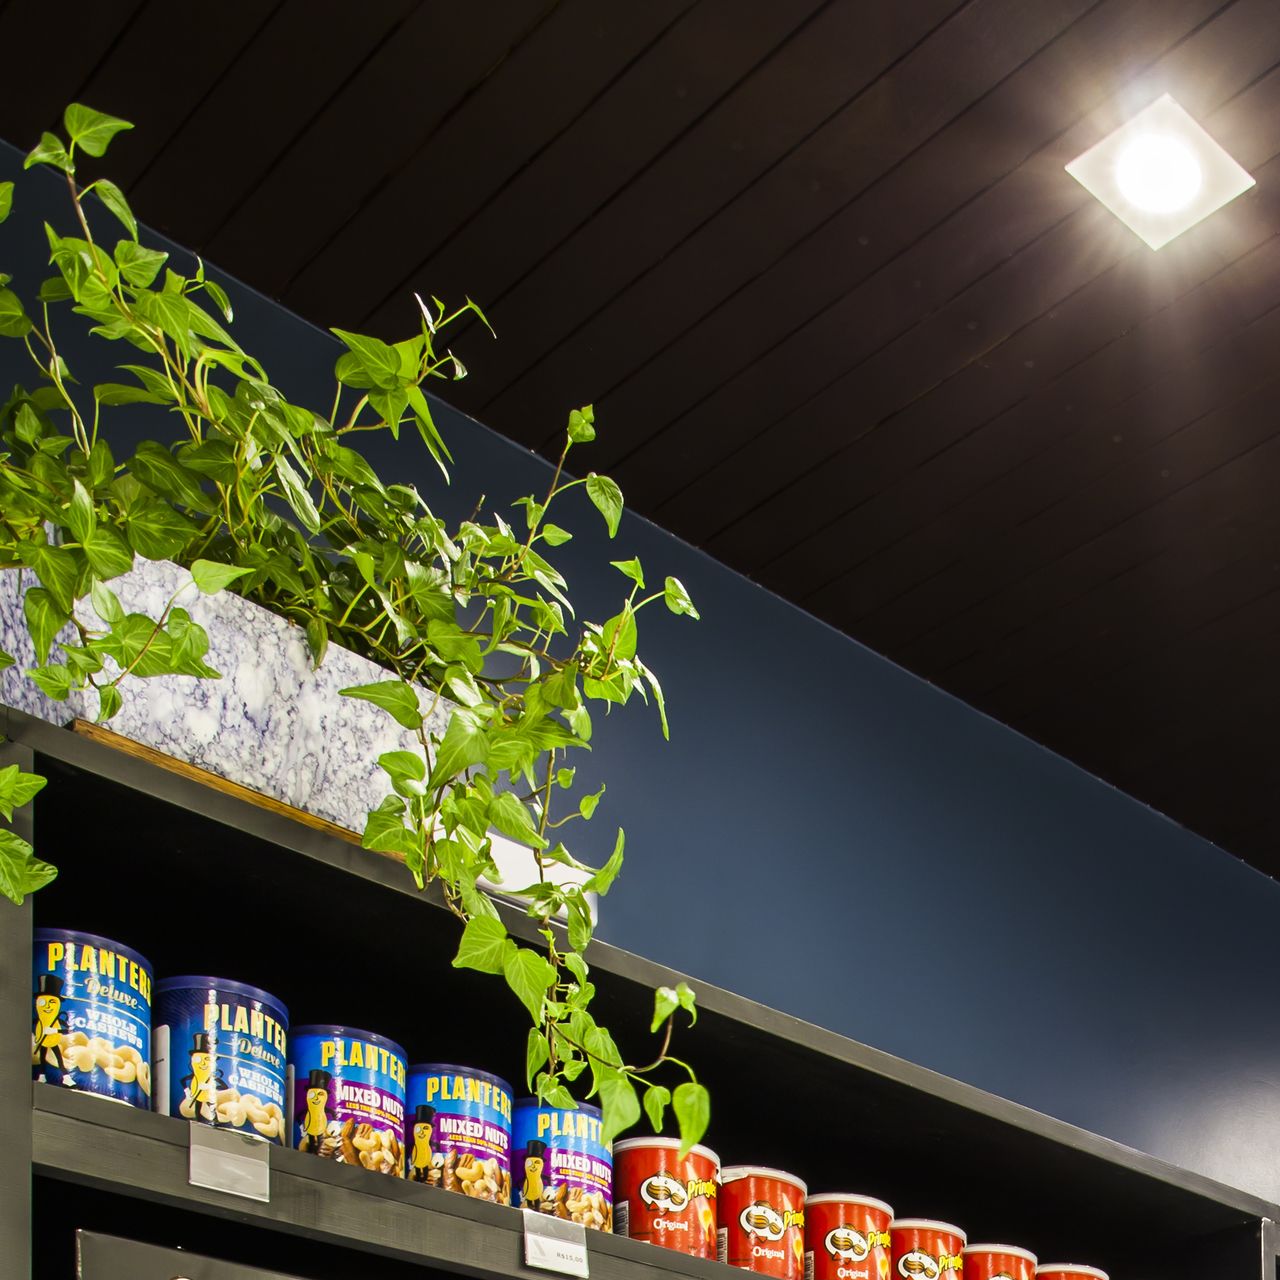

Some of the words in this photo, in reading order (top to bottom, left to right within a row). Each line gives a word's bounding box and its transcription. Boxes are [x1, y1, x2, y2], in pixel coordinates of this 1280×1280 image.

[84, 977, 139, 1011] Deluxe
[72, 1015, 143, 1049] CASHEWS
[86, 1008, 137, 1035] WHOLE
[238, 1037, 282, 1068] Deluxe
[321, 1041, 405, 1092] PLANTER
[239, 1067, 280, 1092] WHOLE
[337, 1084, 381, 1108] MIXED
[383, 1095, 404, 1121] NUTS
[440, 1117, 483, 1137] MIXED
[485, 1126, 508, 1150] NUTS
[551, 1152, 592, 1173] MIXED
[592, 1160, 612, 1184] NUTS
[653, 1217, 689, 1232] Original
[752, 1246, 785, 1260] Original
[837, 1267, 868, 1280] Original
